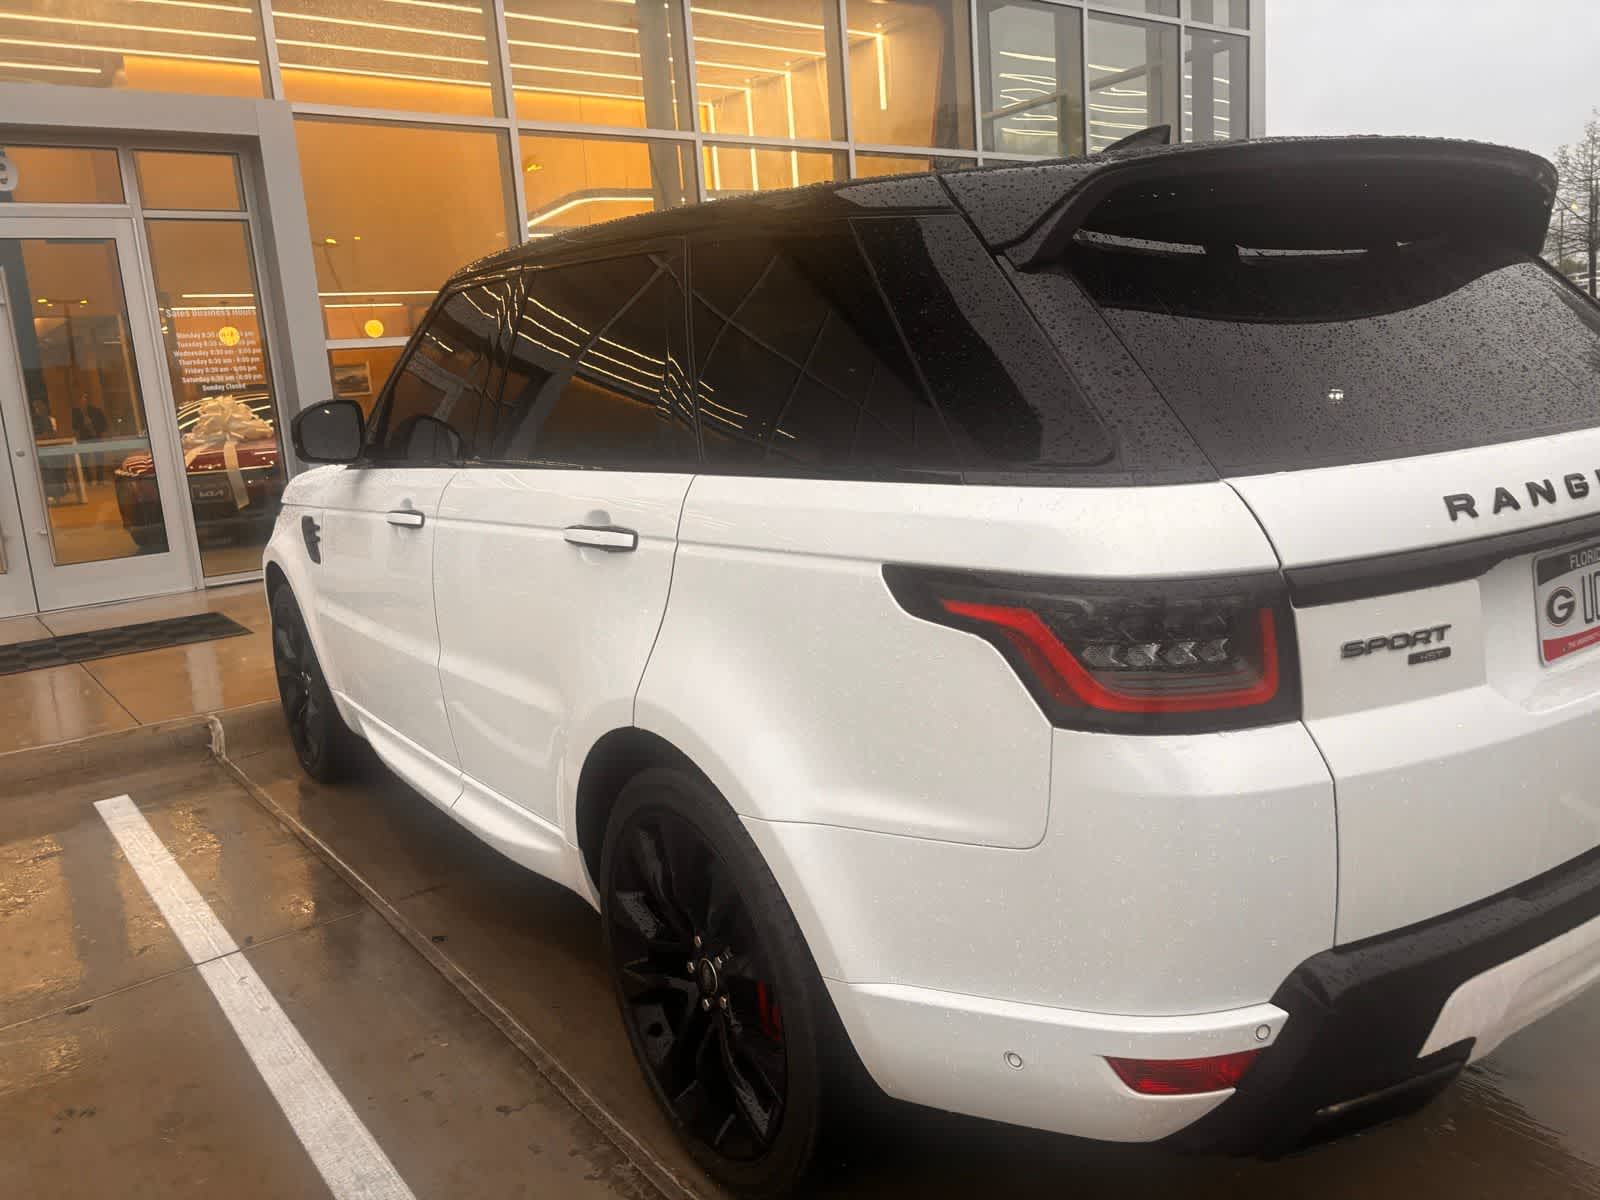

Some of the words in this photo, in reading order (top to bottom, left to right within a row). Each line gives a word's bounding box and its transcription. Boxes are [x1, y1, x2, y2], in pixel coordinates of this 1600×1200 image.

[166, 309, 190, 318] Sales
[192, 308, 231, 317] Business
[174, 349, 208, 357] Wednesday
[179, 358, 207, 367] Thursday
[184, 367, 204, 375] Friday
[182, 376, 210, 384] Saturday
[1442, 468, 1600, 521] RANG
[1546, 588, 1576, 625] G
[1340, 624, 1452, 659] SPORT
